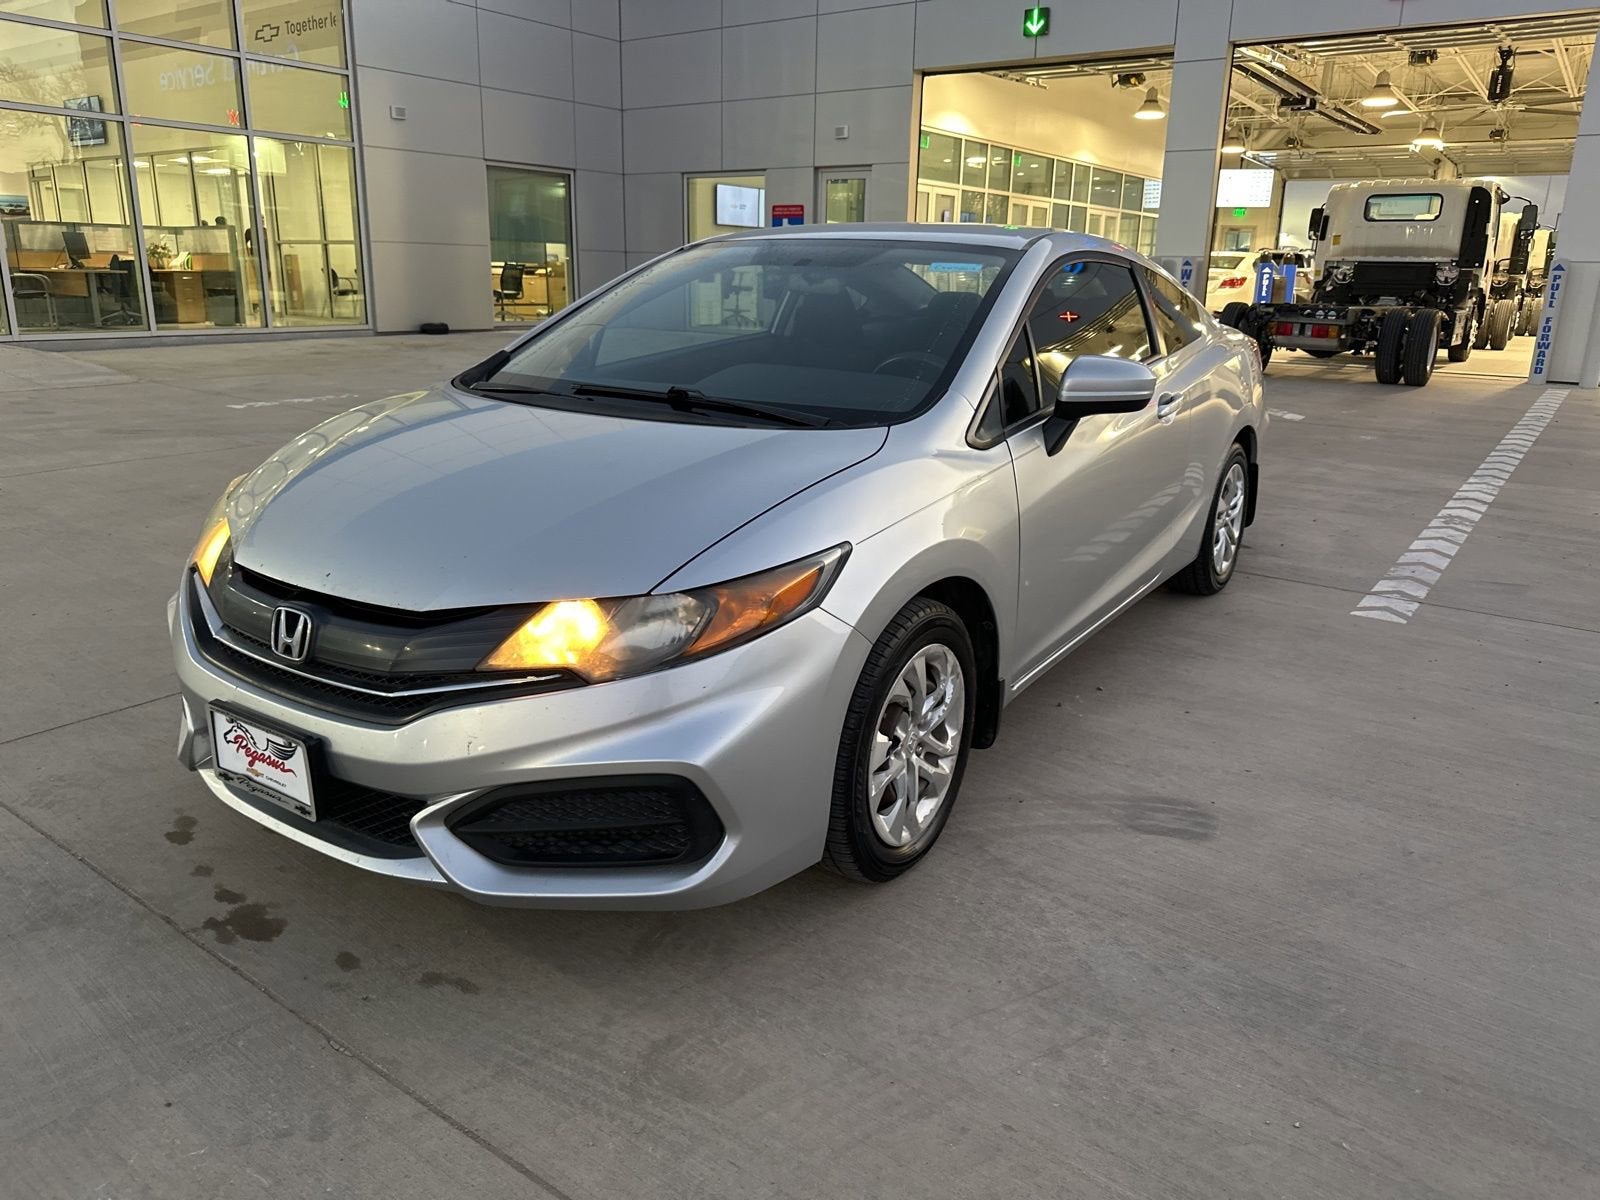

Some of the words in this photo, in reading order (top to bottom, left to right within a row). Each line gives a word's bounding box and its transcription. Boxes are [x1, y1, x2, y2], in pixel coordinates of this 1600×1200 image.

[284, 15, 328, 36] Together
[1548, 274, 1562, 308] PULL
[1533, 316, 1552, 375] FORWARD
[233, 734, 297, 777] Pegasus
[236, 776, 288, 804] Pegasus
